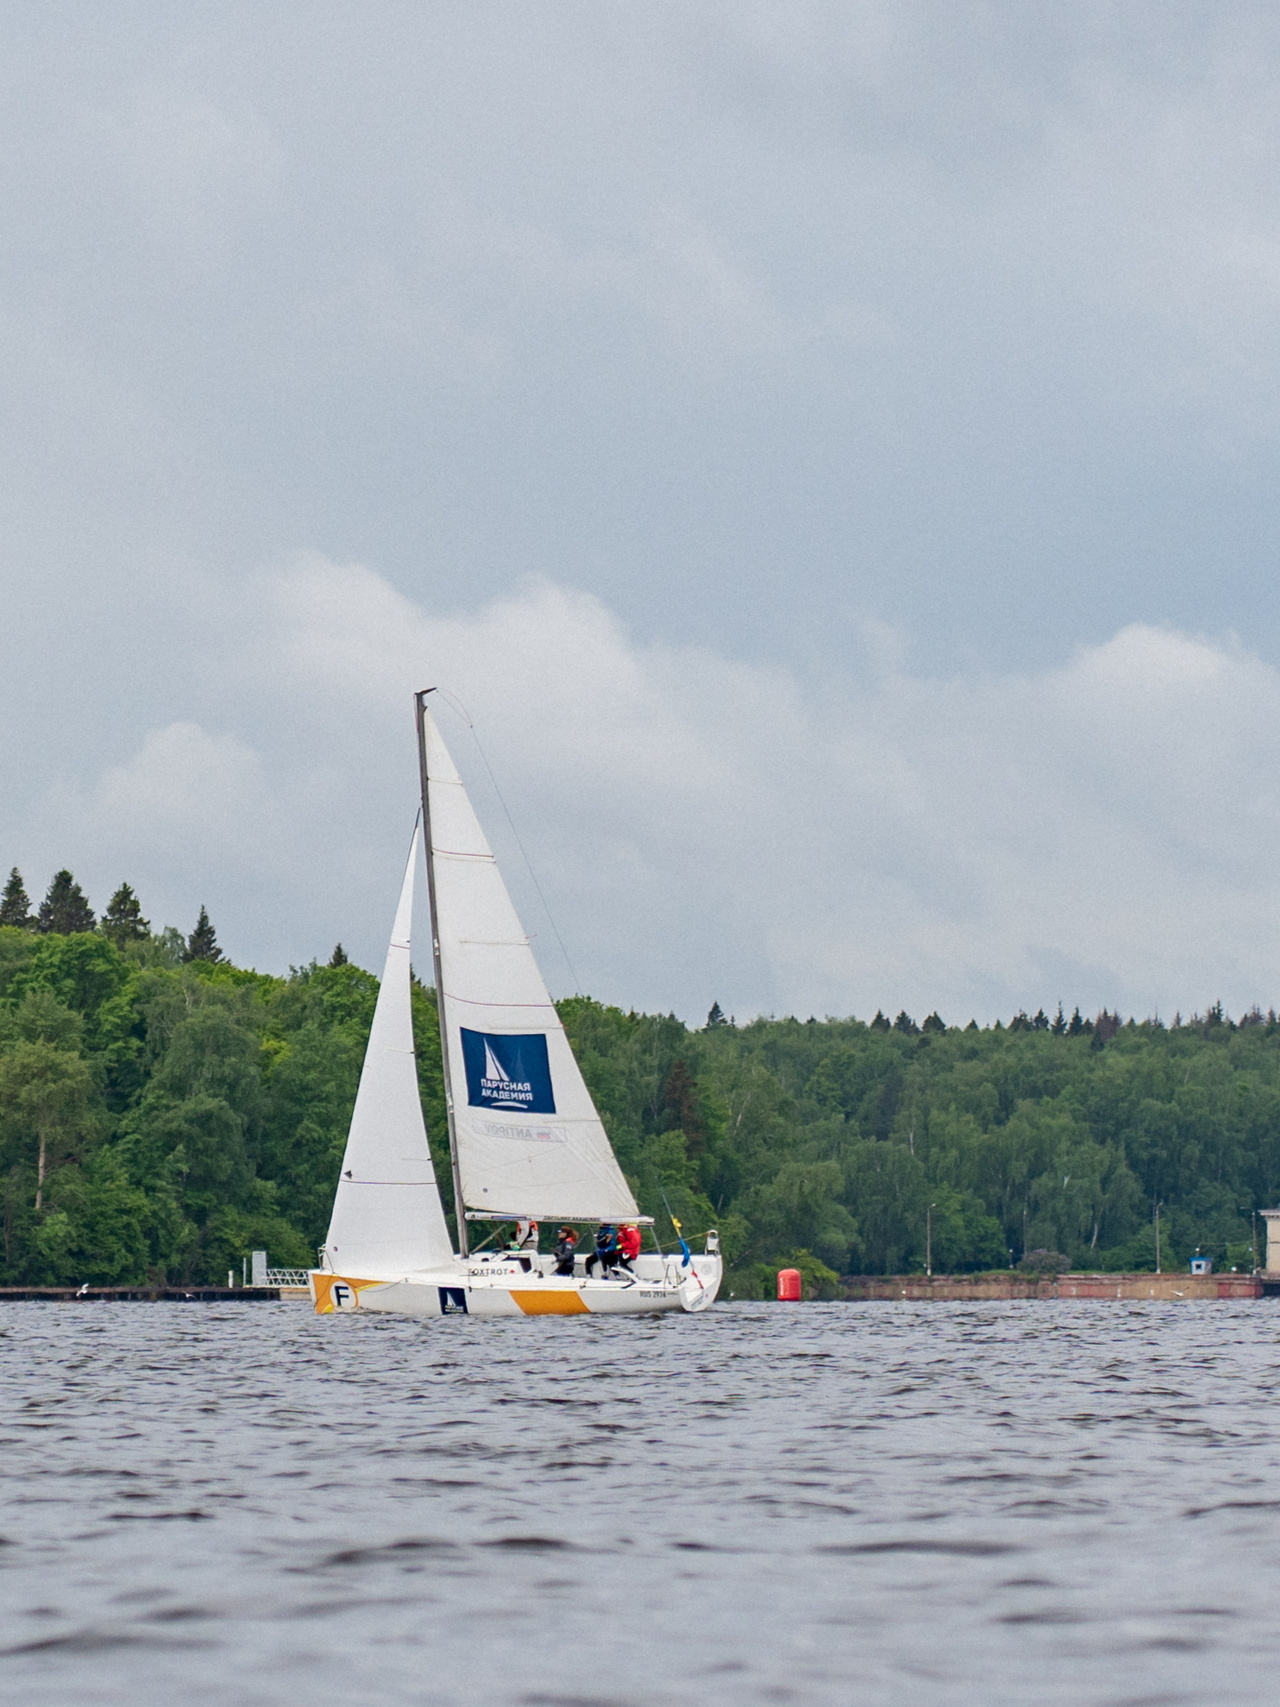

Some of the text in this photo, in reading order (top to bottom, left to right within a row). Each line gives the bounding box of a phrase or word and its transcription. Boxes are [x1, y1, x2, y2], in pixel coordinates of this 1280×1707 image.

[480, 1078, 531, 1091] ПАРУСНАЯ
[481, 1088, 533, 1101] АКАДЕМИЯ
[468, 1268, 508, 1276] FOXTROT
[334, 1285, 350, 1307] F
